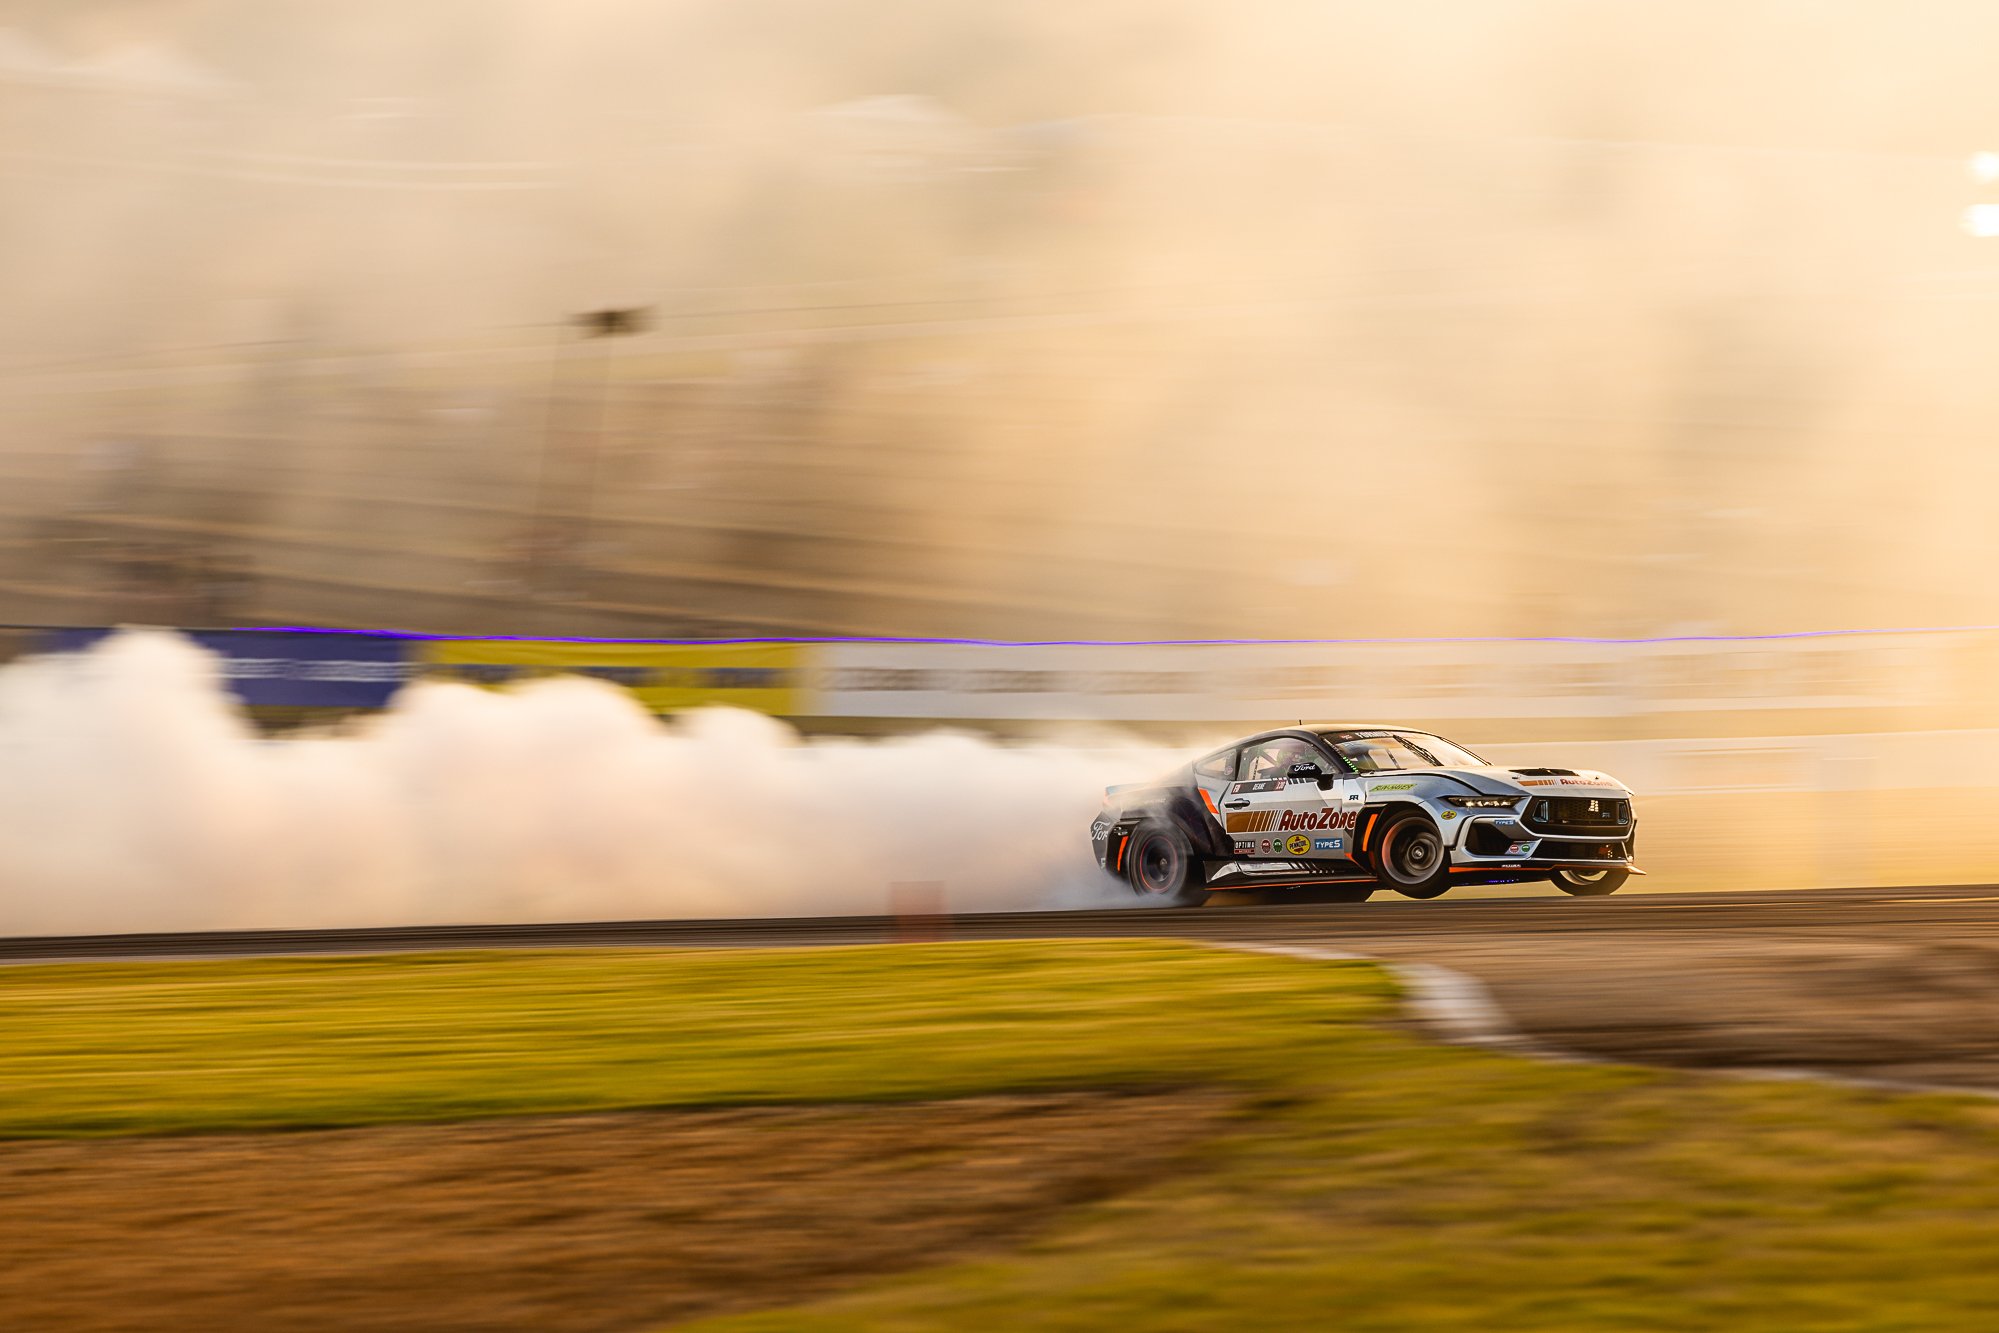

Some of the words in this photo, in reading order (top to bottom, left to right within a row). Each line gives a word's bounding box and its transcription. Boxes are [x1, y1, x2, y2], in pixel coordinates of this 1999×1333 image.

[1294, 762, 1316, 772] Ford
[1278, 807, 1358, 832] AutoZone
[1235, 841, 1255, 849] OPTIMA
